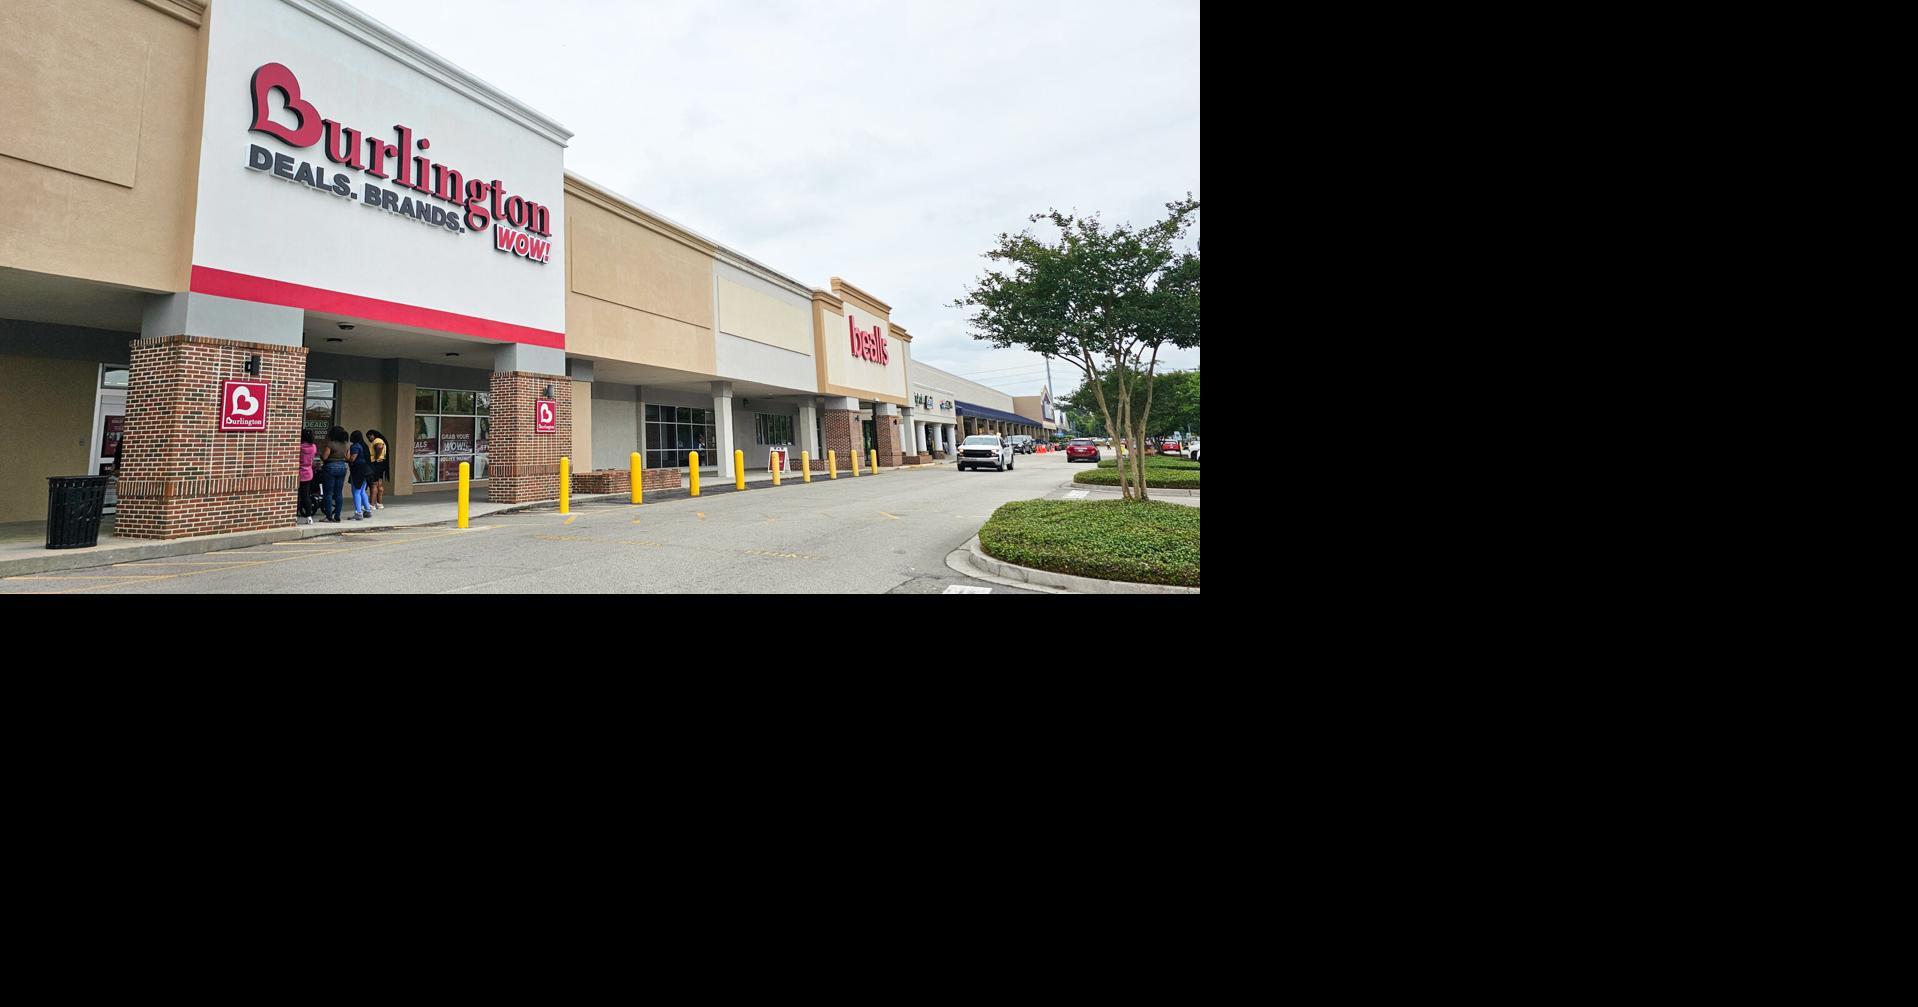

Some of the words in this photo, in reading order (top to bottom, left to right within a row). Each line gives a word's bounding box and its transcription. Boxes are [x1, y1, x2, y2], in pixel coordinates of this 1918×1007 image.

[249, 62, 552, 237] Burlington
[248, 144, 358, 200] DEALS.
[362, 183, 466, 233] BRANDS.
[497, 225, 551, 263] WOW!
[848, 315, 889, 366] bealls
[225, 416, 262, 426] Burlington
[413, 440, 428, 449] EALS
